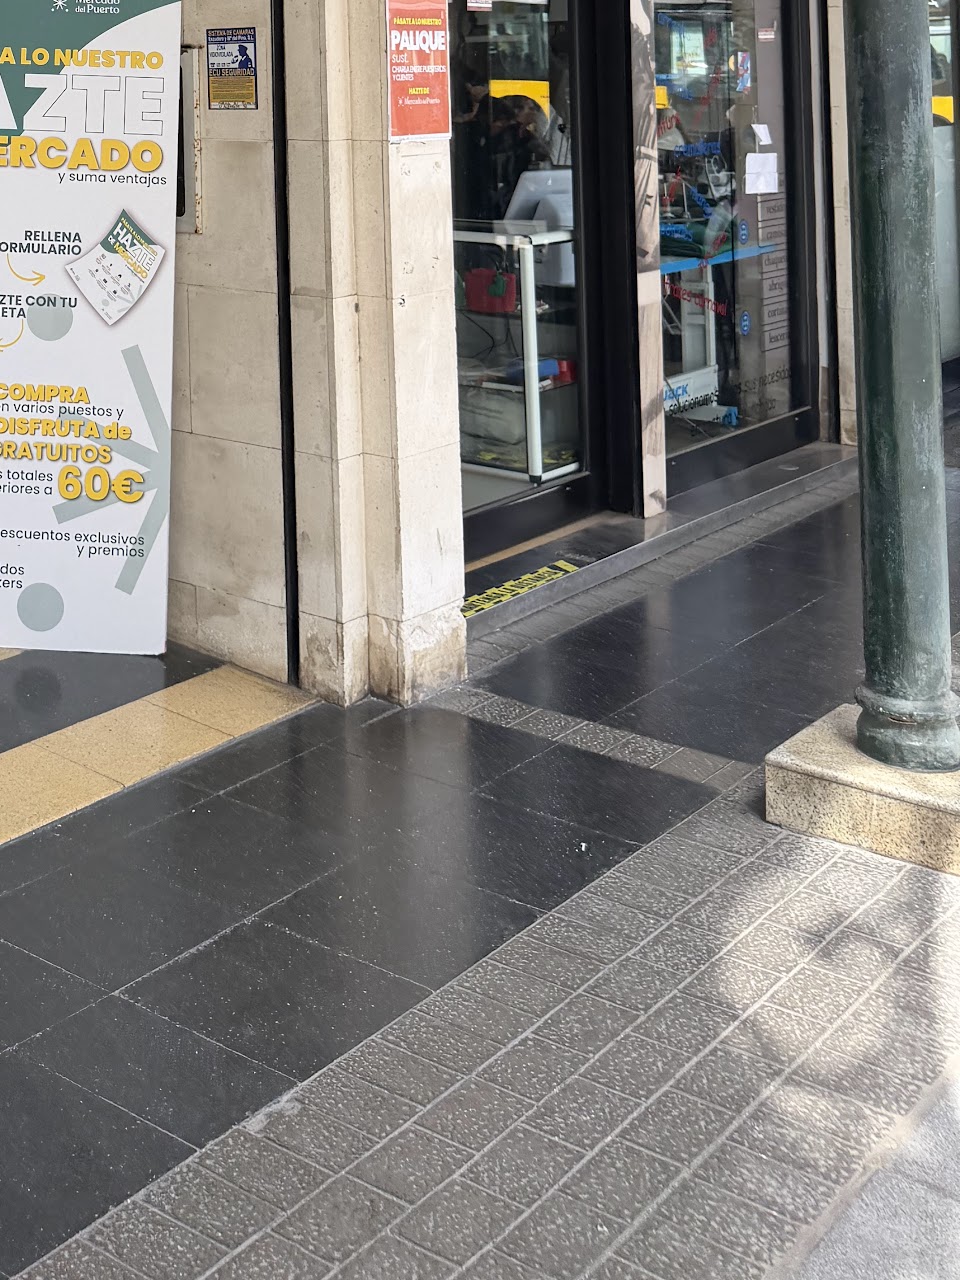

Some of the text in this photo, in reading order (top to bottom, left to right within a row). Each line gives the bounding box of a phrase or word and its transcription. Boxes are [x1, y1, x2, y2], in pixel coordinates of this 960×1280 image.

[75, 3, 120, 15] del Puerto
[391, 30, 446, 54] PALIQUE
[20, 47, 50, 66] LO
[54, 48, 164, 70] NUESTRO
[209, 68, 255, 76] ECU SEGURIDAD
[58, 172, 168, 188] y suma ventajas
[24, 230, 82, 243] RELLENA
[113, 222, 156, 272] HAZTE
[25, 295, 57, 308] CON
[59, 297, 78, 309] TU
[13, 402, 55, 414] varios
[58, 404, 113, 418] puestos
[116, 408, 124, 420] y
[103, 421, 132, 441] de
[6, 469, 54, 482] totales
[44, 485, 53, 495] a
[57, 464, 145, 504] 60€
[74, 531, 145, 546] exclusivos
[76, 544, 145, 558] y premios
